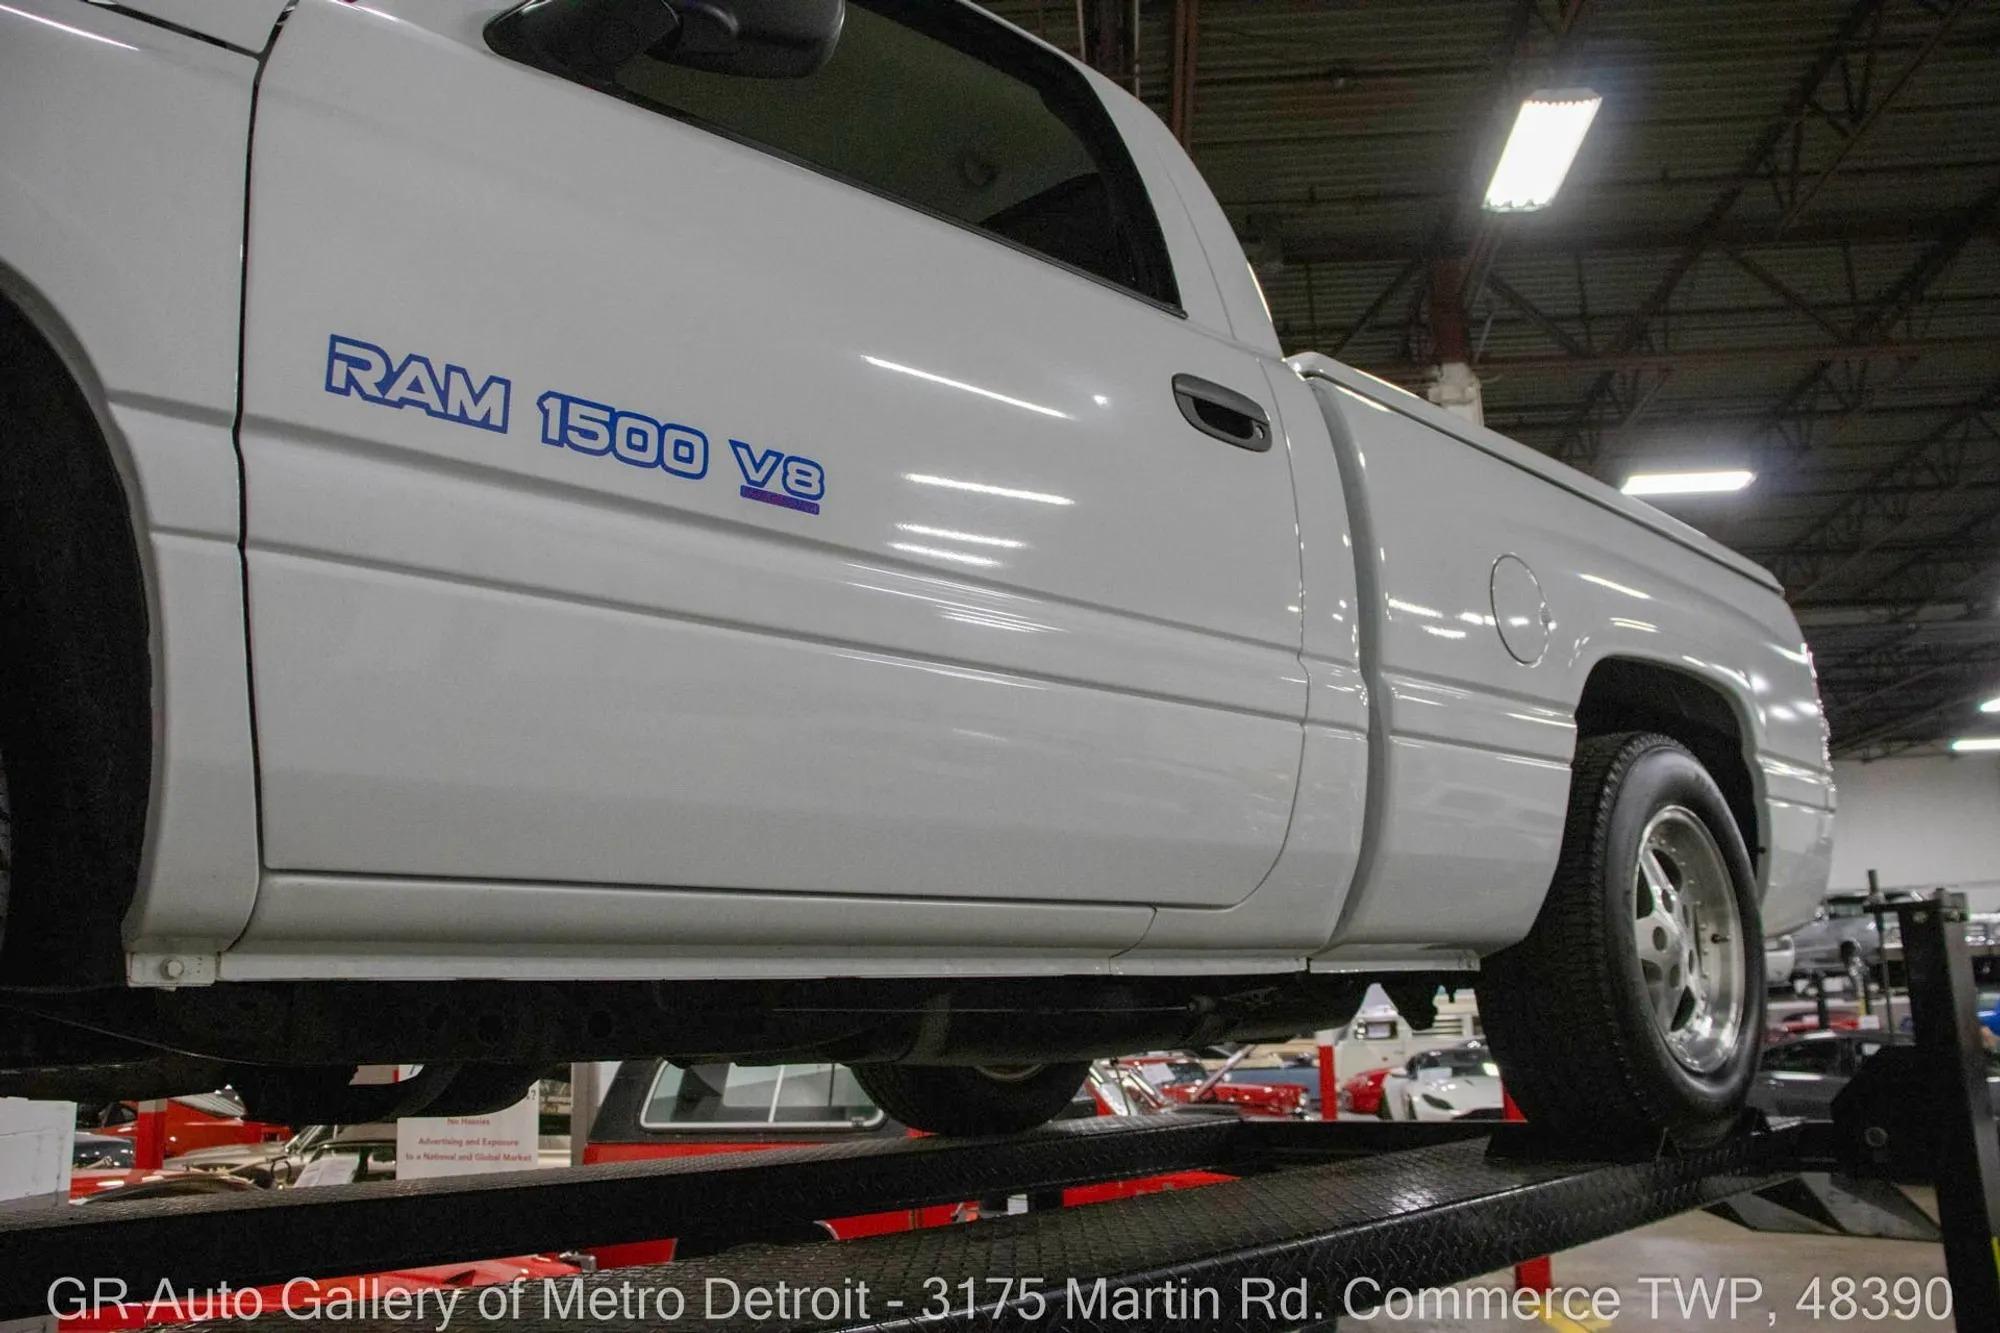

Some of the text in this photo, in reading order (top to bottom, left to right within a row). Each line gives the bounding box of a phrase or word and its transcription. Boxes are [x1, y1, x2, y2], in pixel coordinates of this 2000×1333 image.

[325, 333, 825, 500] RAM 1500 V8
[418, 1138, 519, 1148] Advertising and Exposure
[423, 1153, 456, 1161] National
[458, 1153, 473, 1161] and
[474, 1153, 501, 1161] Global
[502, 1153, 532, 1161] Market
